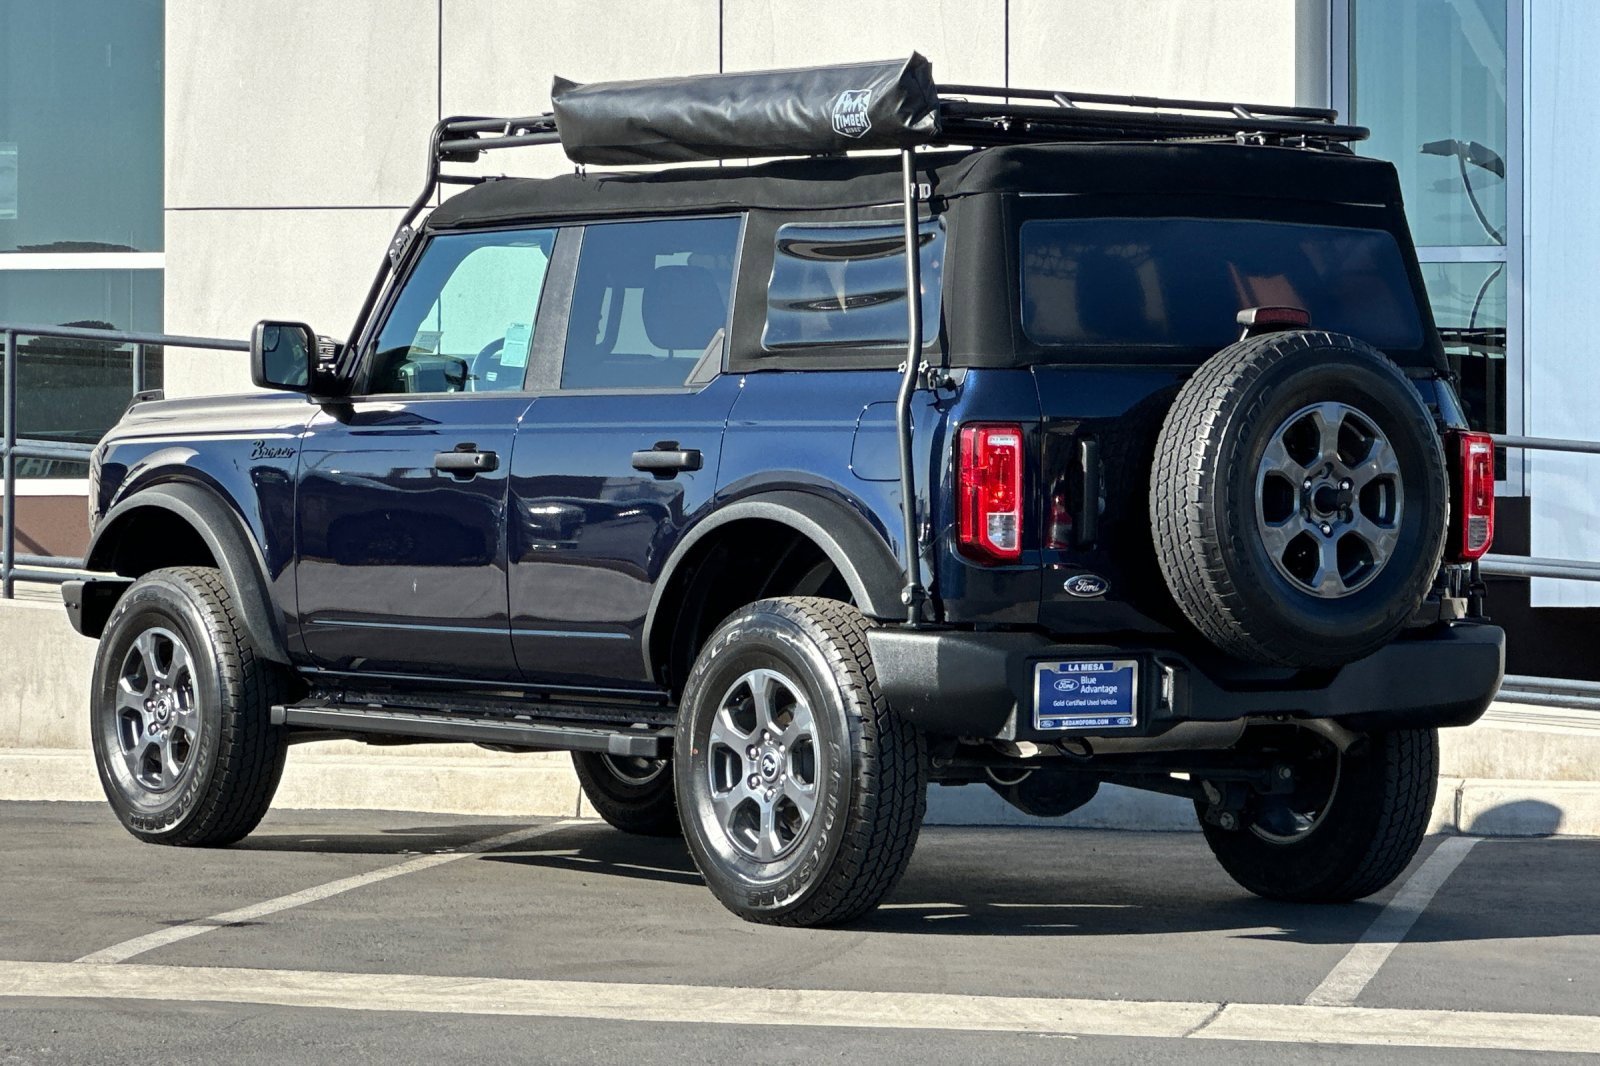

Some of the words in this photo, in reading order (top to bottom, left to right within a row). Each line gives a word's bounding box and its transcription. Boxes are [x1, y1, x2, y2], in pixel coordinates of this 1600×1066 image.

[834, 112, 868, 130] TIMBER
[249, 440, 297, 460] Bronco
[1081, 663, 1104, 671] MESA
[1080, 676, 1097, 685] Blue
[1080, 685, 1118, 695] Advantage
